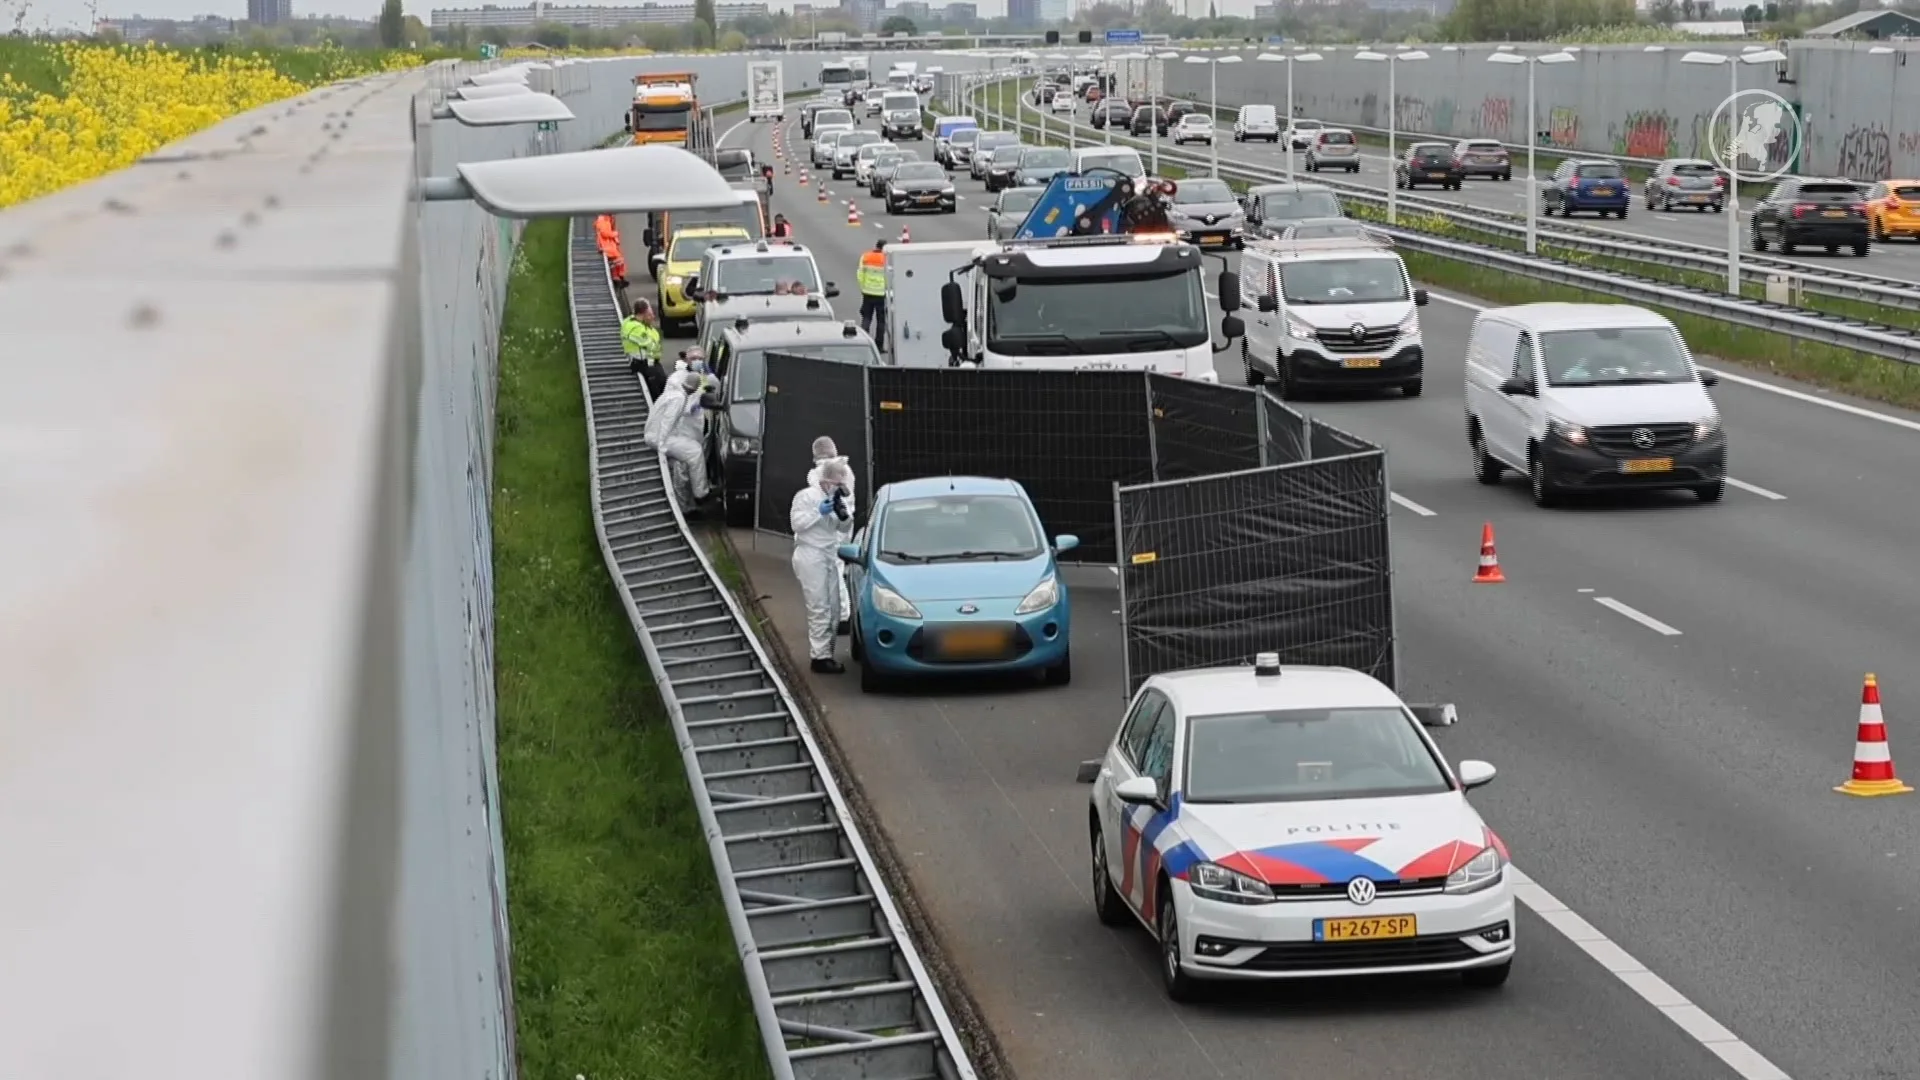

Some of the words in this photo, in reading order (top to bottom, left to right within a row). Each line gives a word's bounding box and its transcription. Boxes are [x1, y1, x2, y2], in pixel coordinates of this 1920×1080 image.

[1067, 179, 1100, 189] FASSI
[1286, 823, 1401, 835] POLITIE
[1329, 919, 1409, 938] H-267-SP
